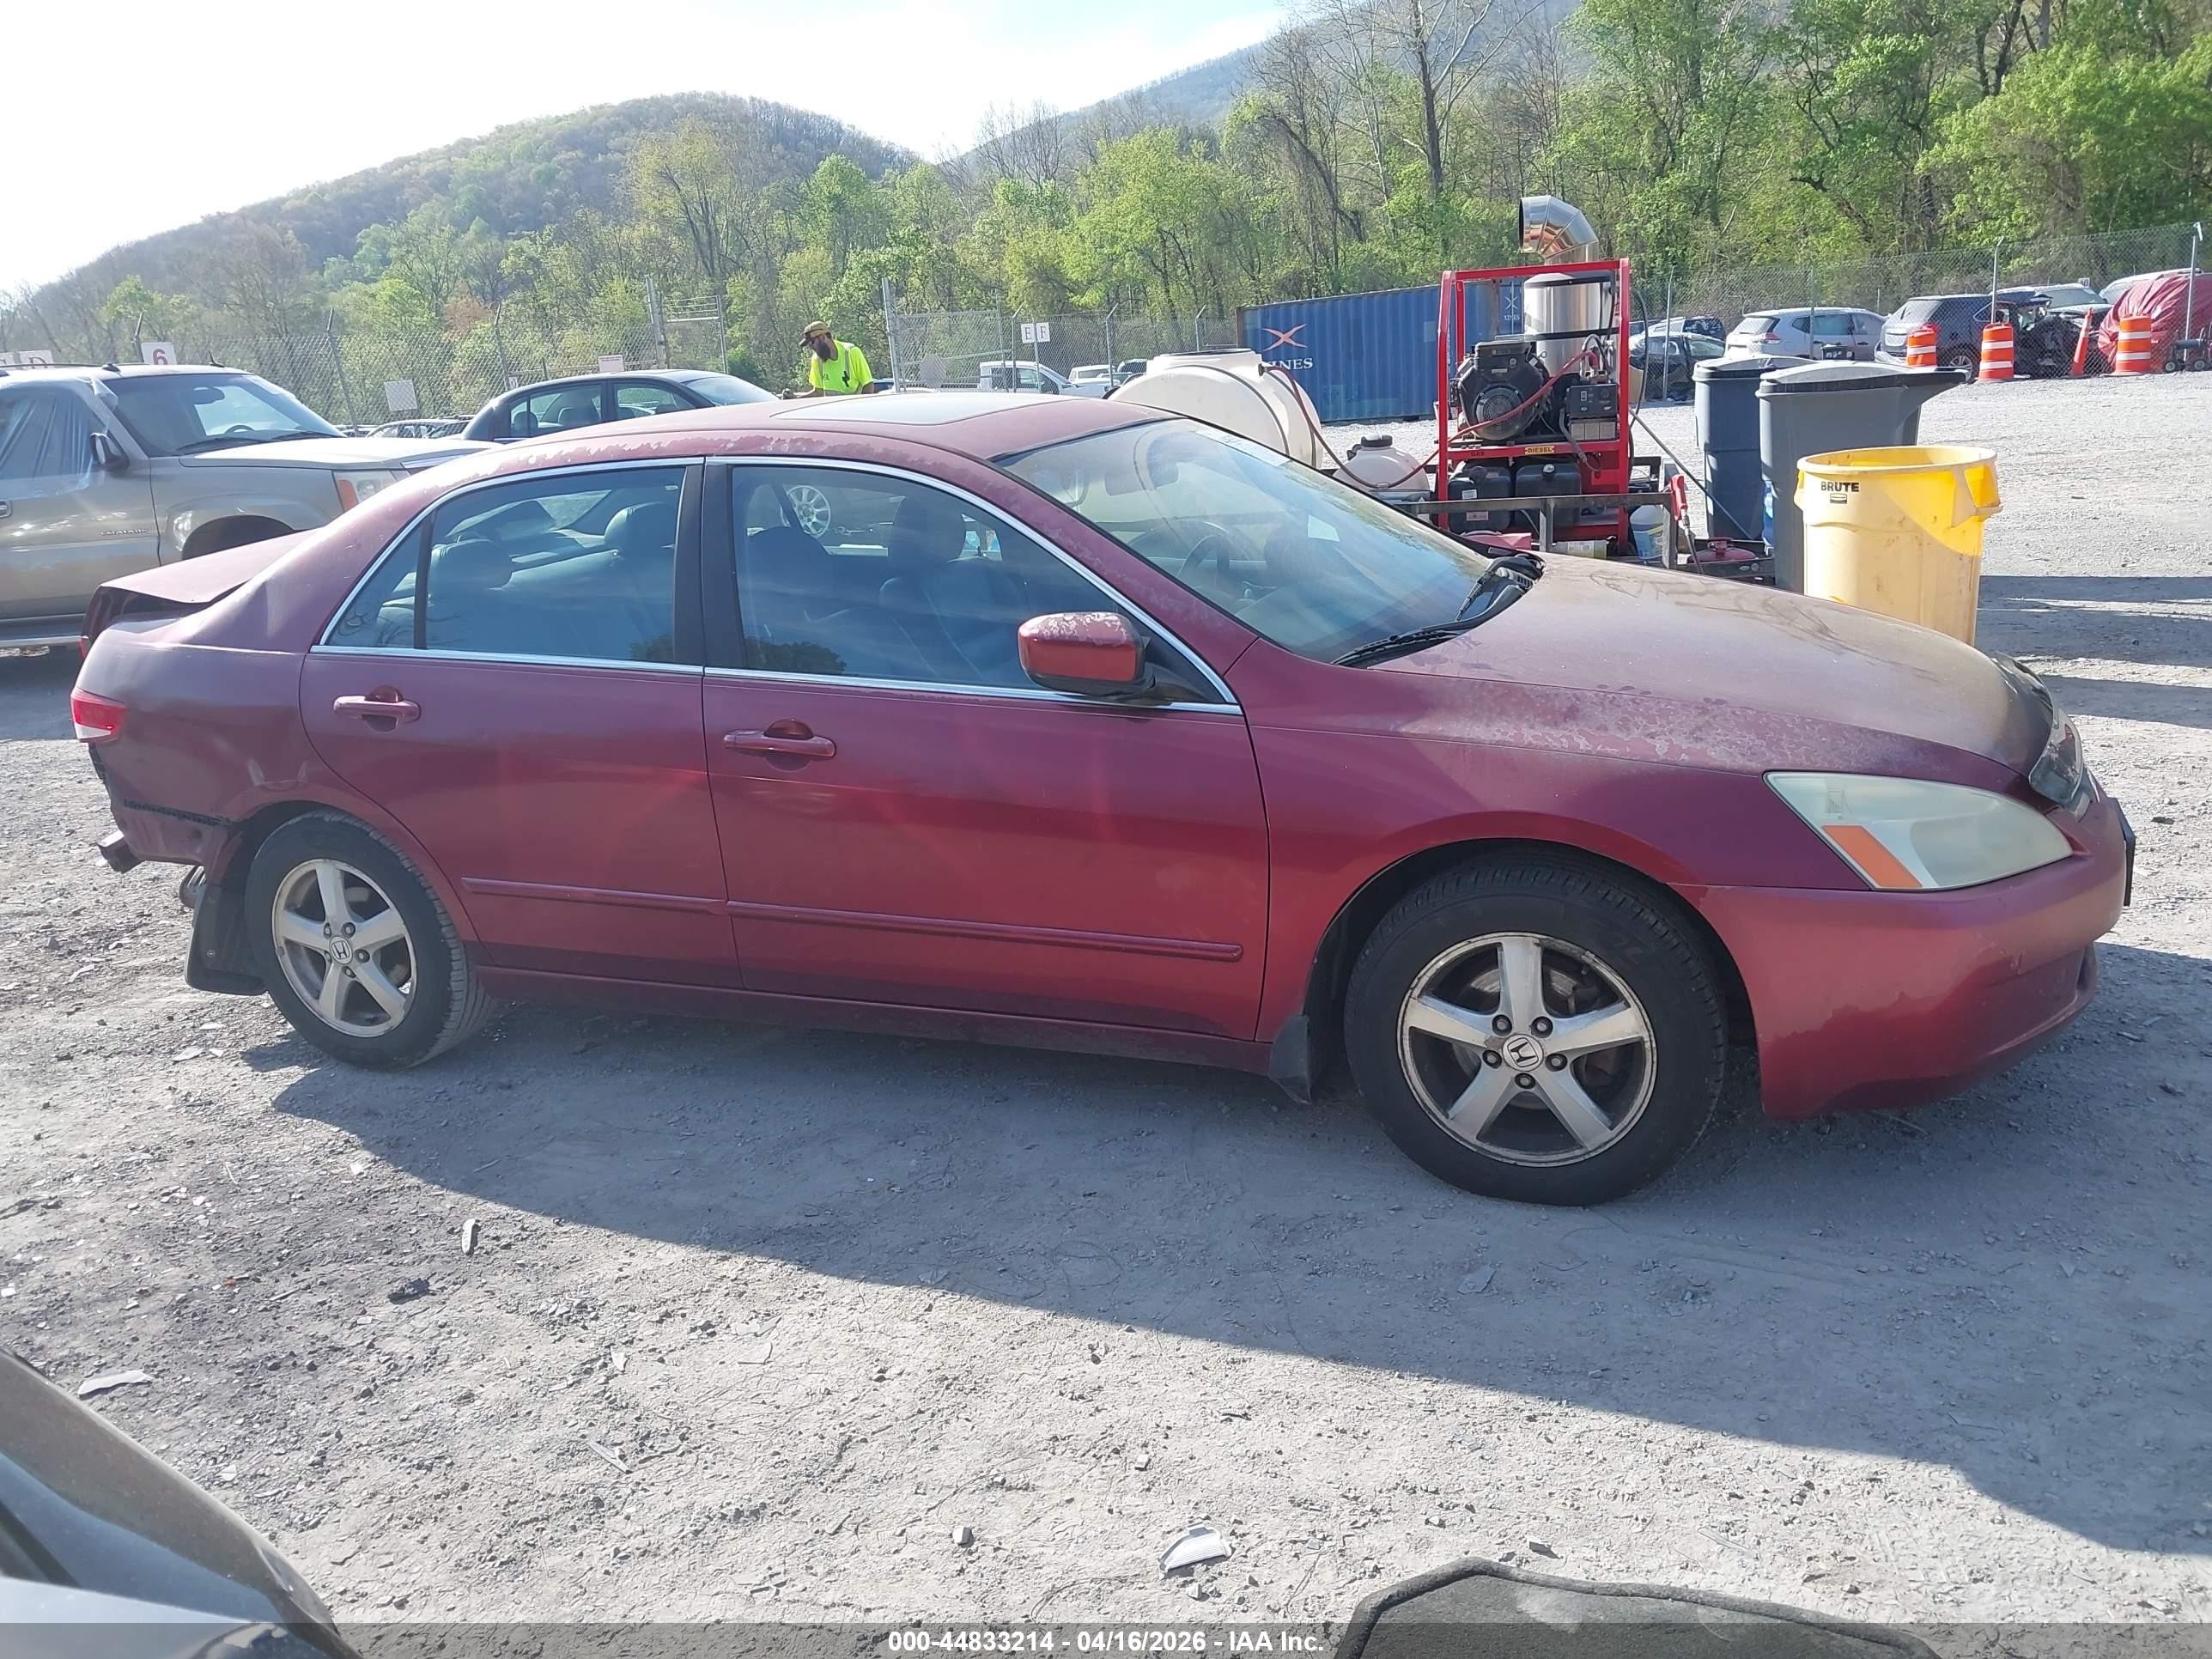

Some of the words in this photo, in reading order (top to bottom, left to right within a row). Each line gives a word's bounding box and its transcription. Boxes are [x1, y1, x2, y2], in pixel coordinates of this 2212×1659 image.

[1024, 326, 1032, 340] E
[1041, 325, 1047, 339] F
[1820, 481, 1860, 493] BRUTE
